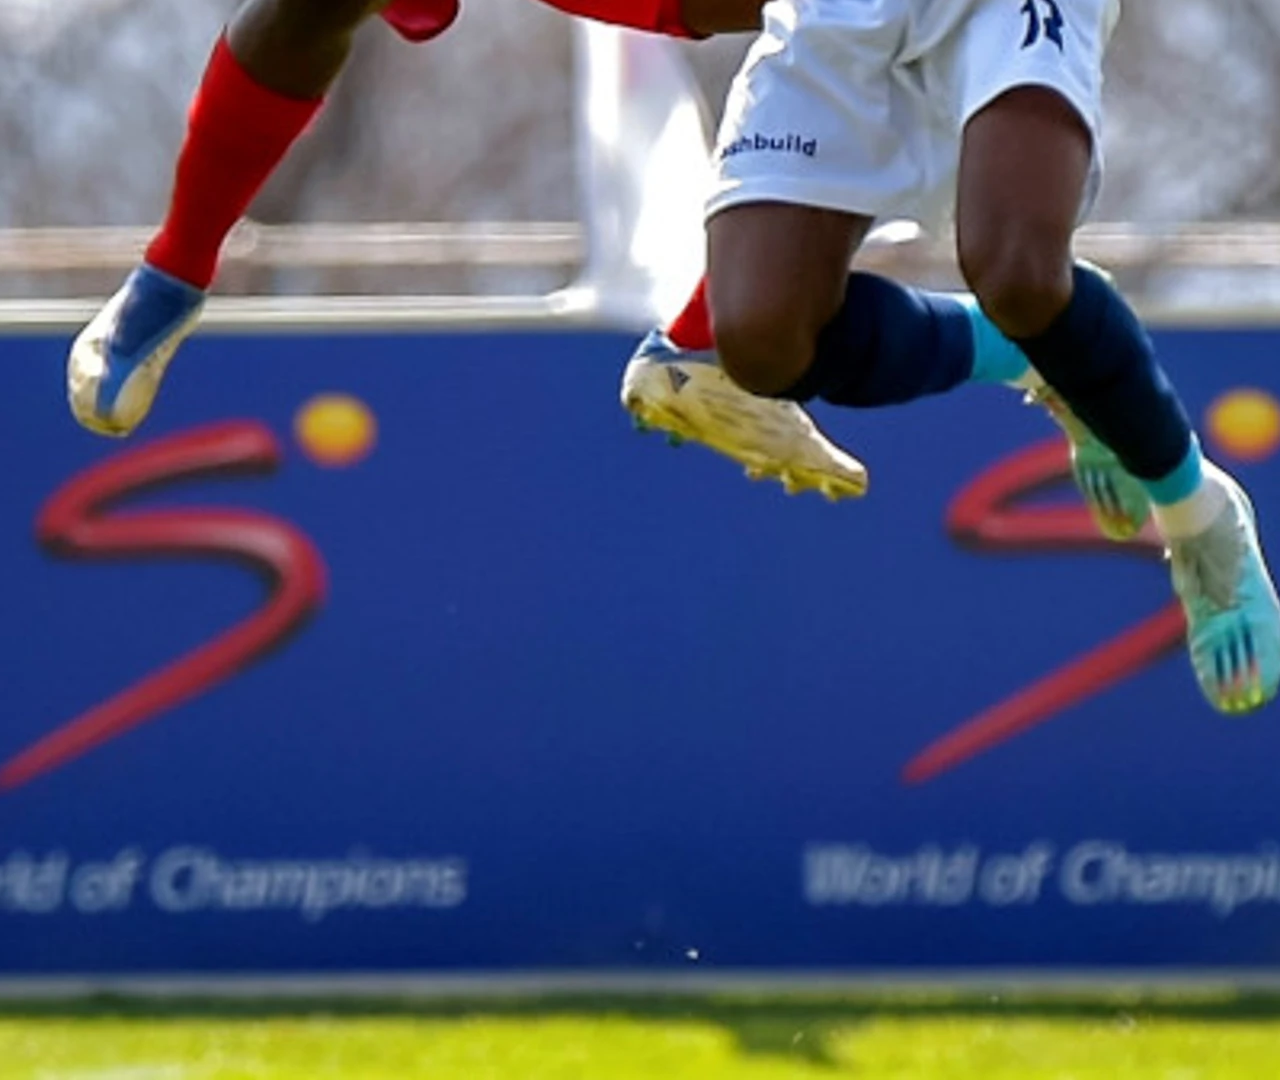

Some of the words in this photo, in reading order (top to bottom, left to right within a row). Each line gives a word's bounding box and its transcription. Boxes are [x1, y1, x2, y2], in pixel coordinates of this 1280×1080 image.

[72, 849, 142, 911] of
[149, 846, 467, 920] Champions
[804, 843, 979, 904] World
[980, 843, 1052, 904] of
